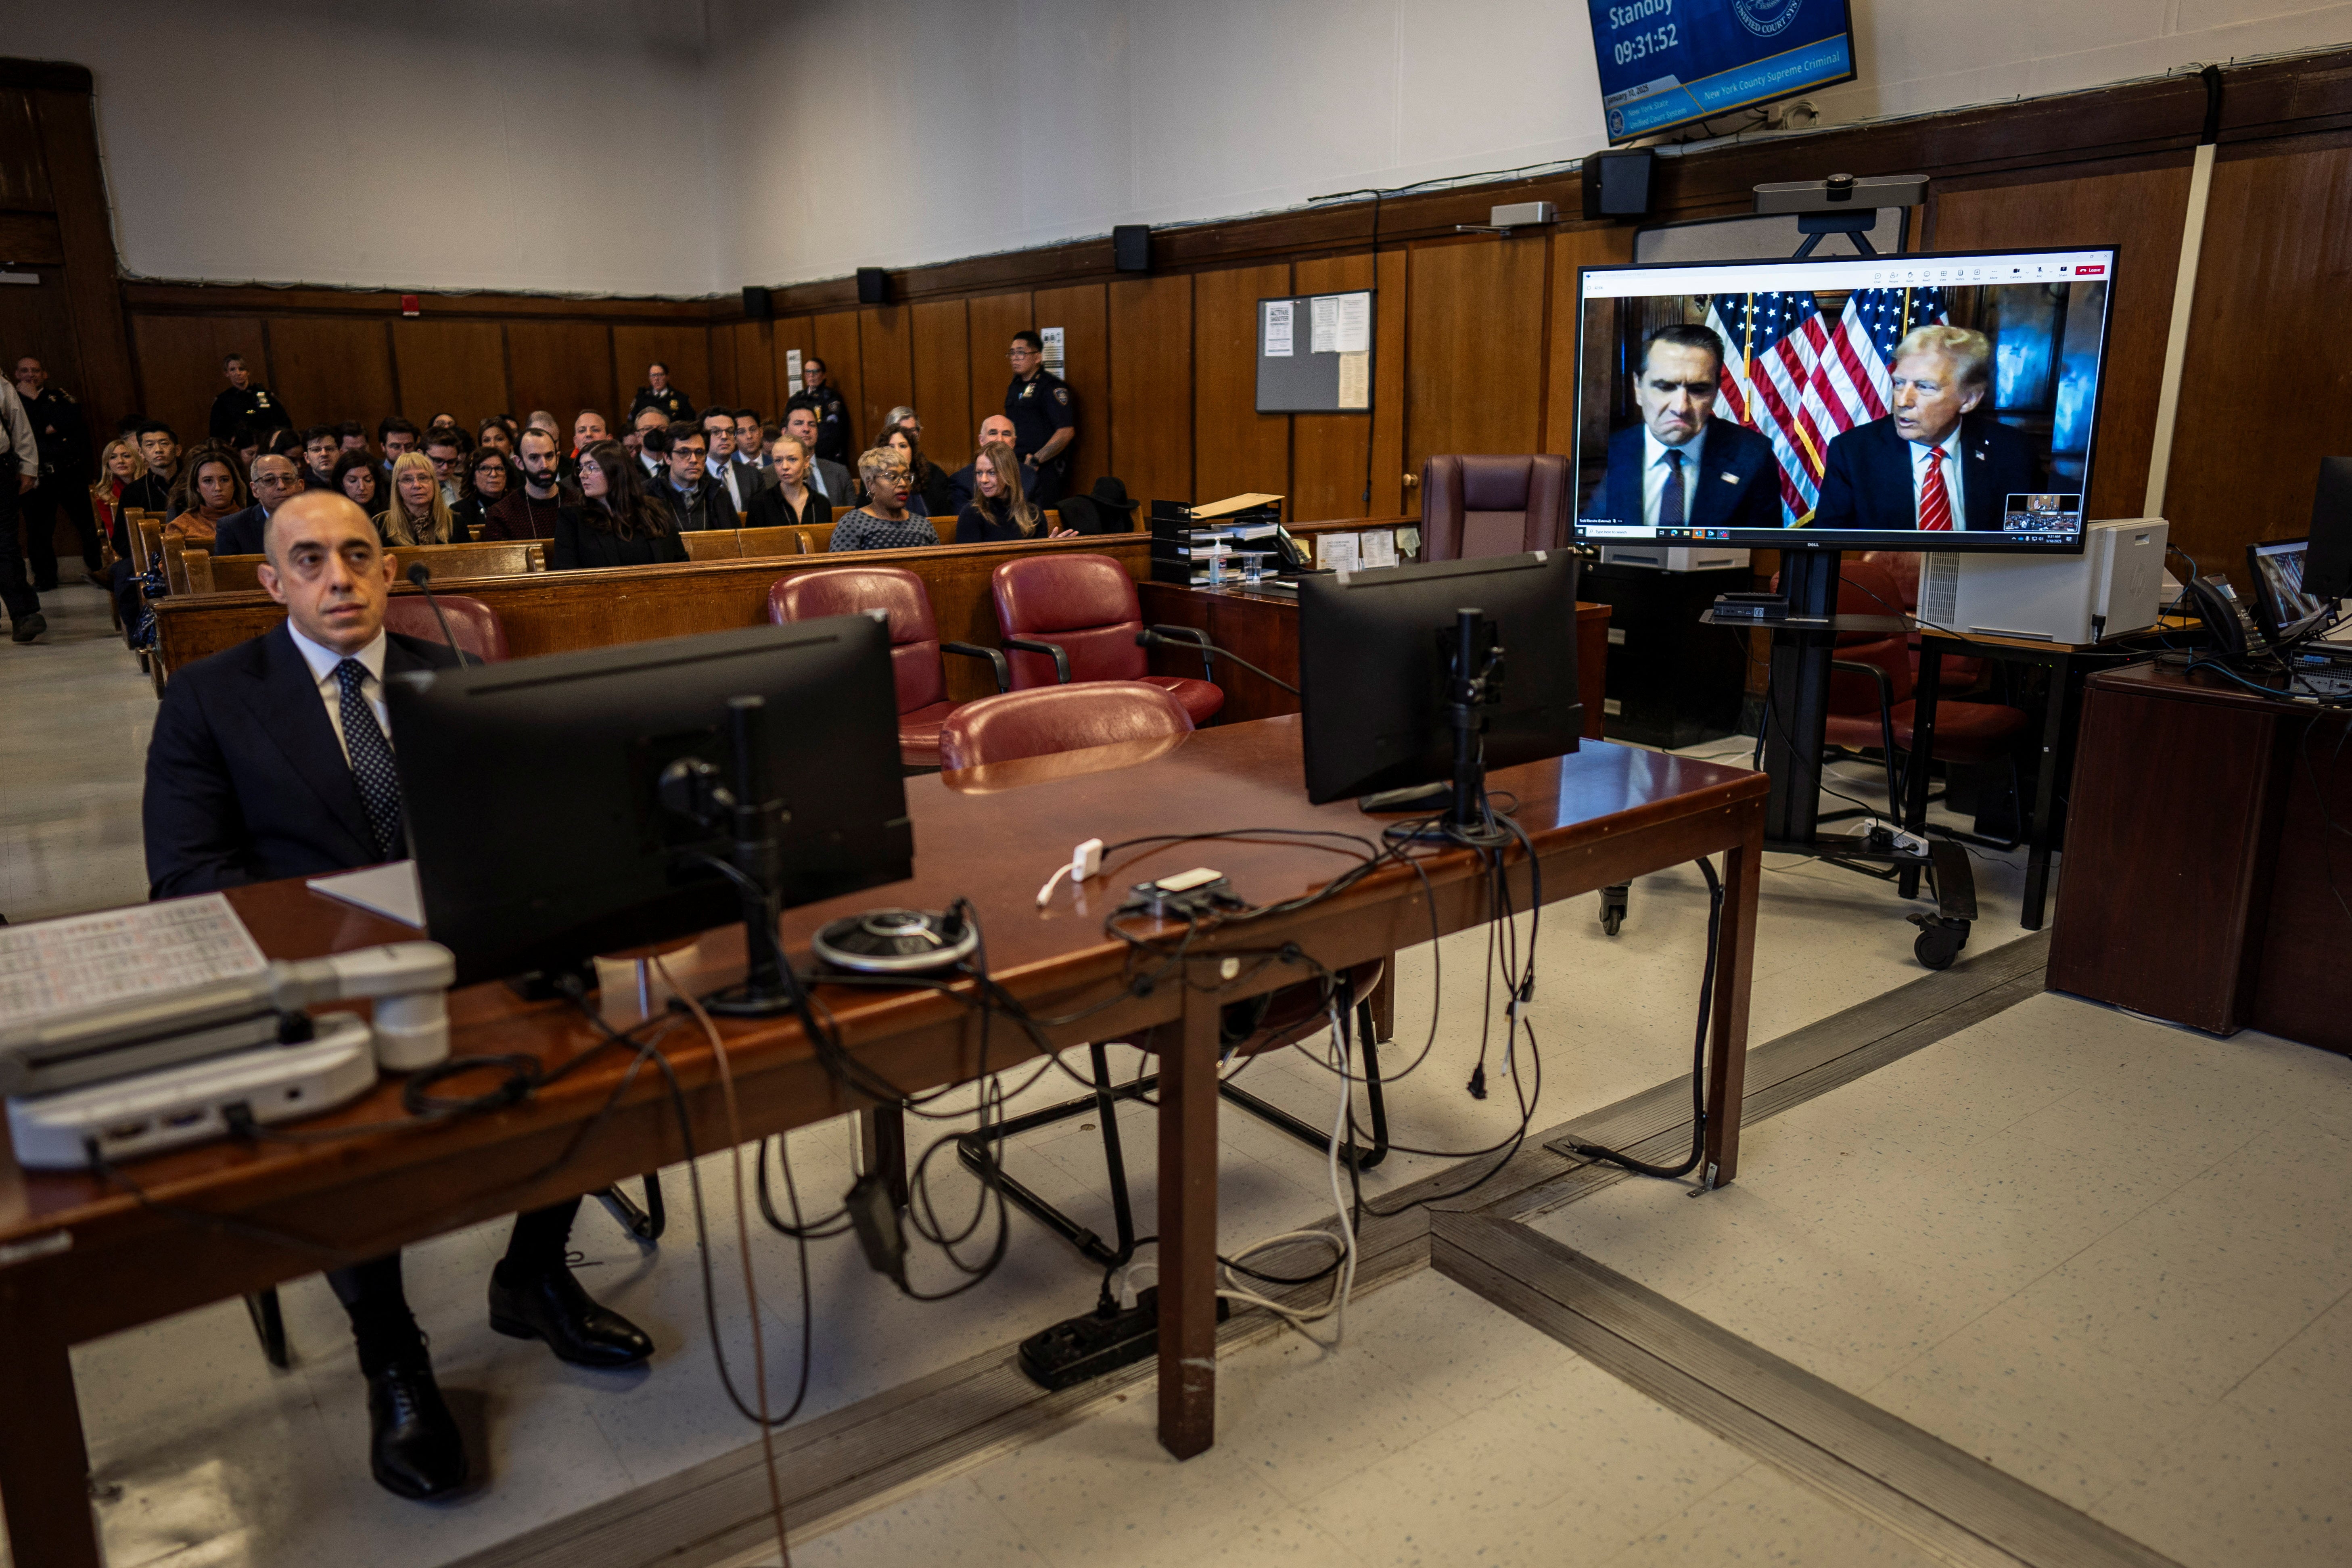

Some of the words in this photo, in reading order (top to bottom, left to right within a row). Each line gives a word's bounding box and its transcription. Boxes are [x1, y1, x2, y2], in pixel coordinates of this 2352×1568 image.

[1609, 0, 1672, 29] Standby
[1736, 1, 1760, 31] UNIFIED
[1762, 16, 1786, 33] COURT
[1786, 0, 1800, 19] SYS
[1615, 23, 1678, 65] 09:31:52
[1704, 91, 1720, 101] New
[1721, 83, 1737, 96] York
[1739, 75, 1766, 90] County
[1767, 65, 1802, 82] Supreme
[1804, 51, 1840, 71] Criminal
